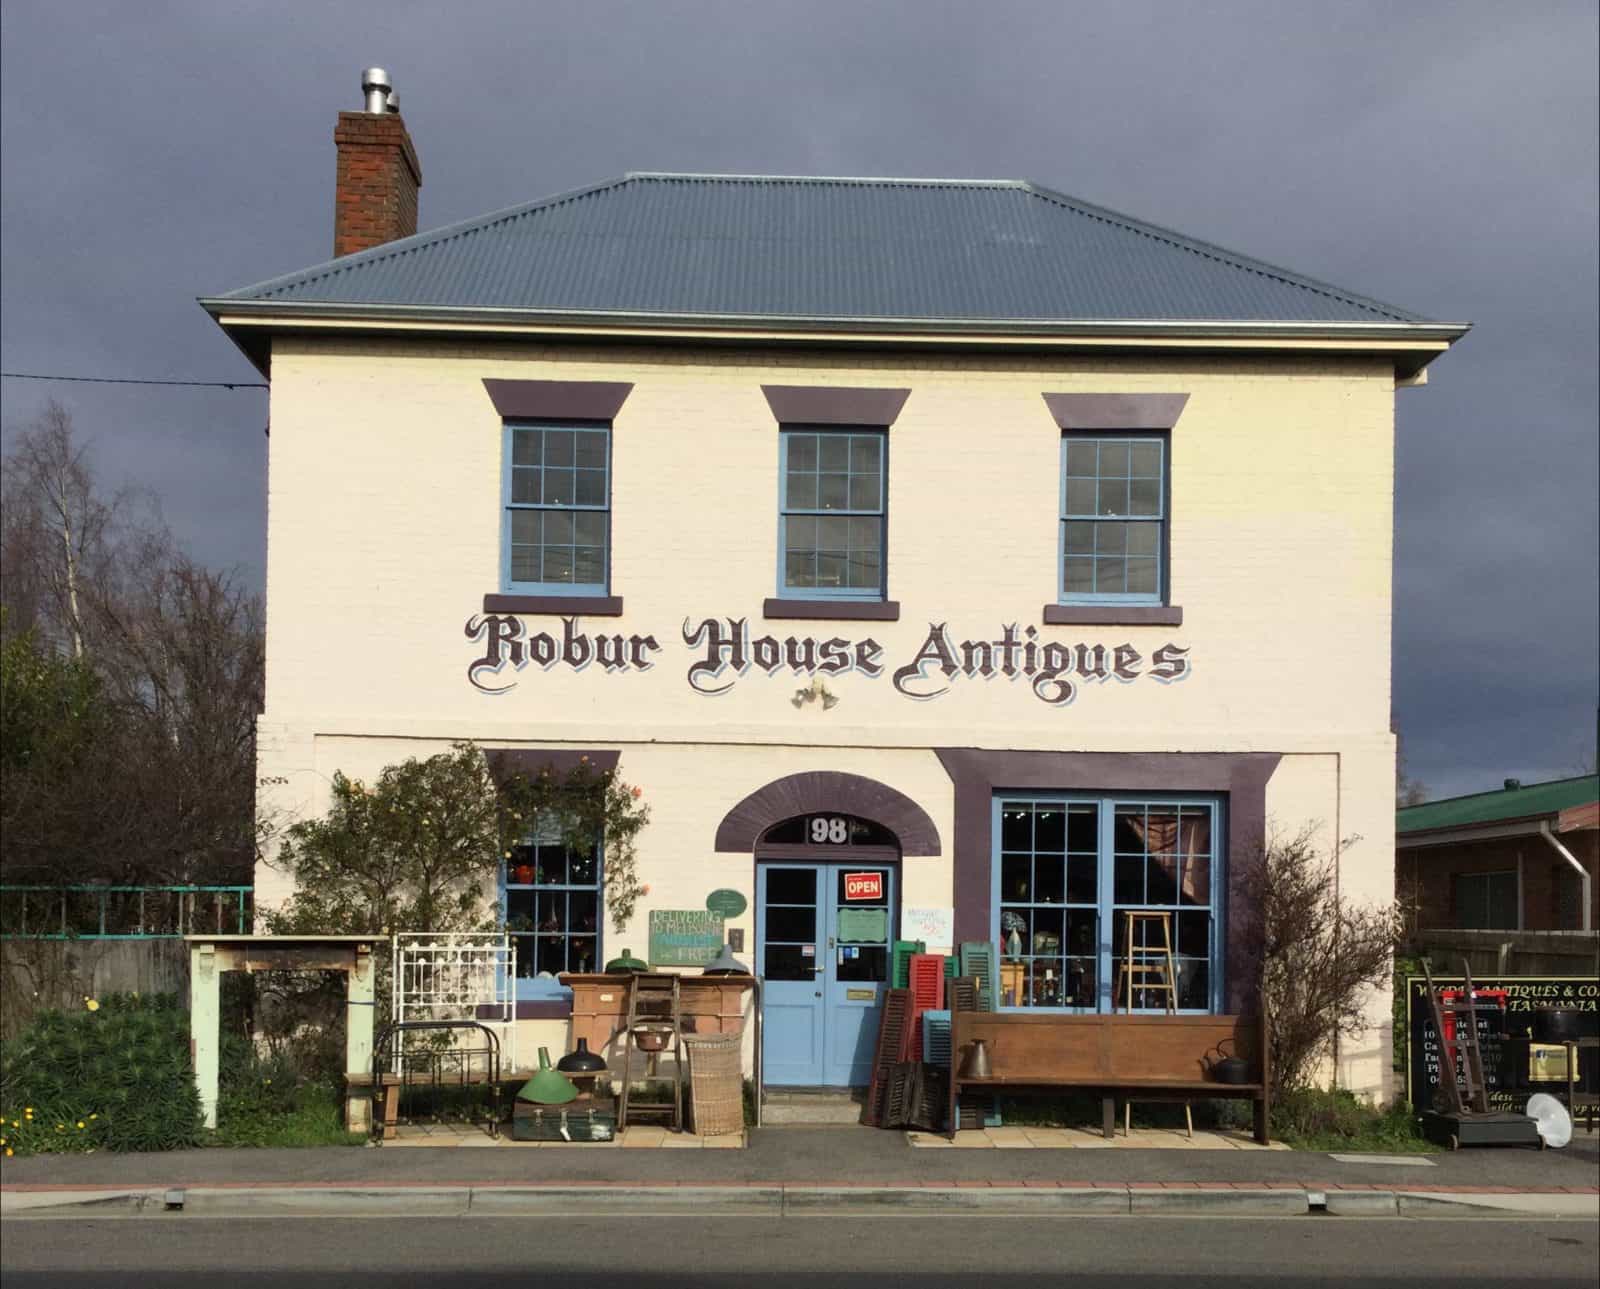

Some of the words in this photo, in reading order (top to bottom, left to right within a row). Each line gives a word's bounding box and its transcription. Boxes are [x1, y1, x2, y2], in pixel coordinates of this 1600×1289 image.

[464, 614, 662, 694] Robur
[682, 616, 884, 695] House
[811, 818, 847, 843] 98
[849, 881, 878, 893] OPEN
[654, 911, 721, 923] DELIVERING
[1563, 986, 1576, 997] &
